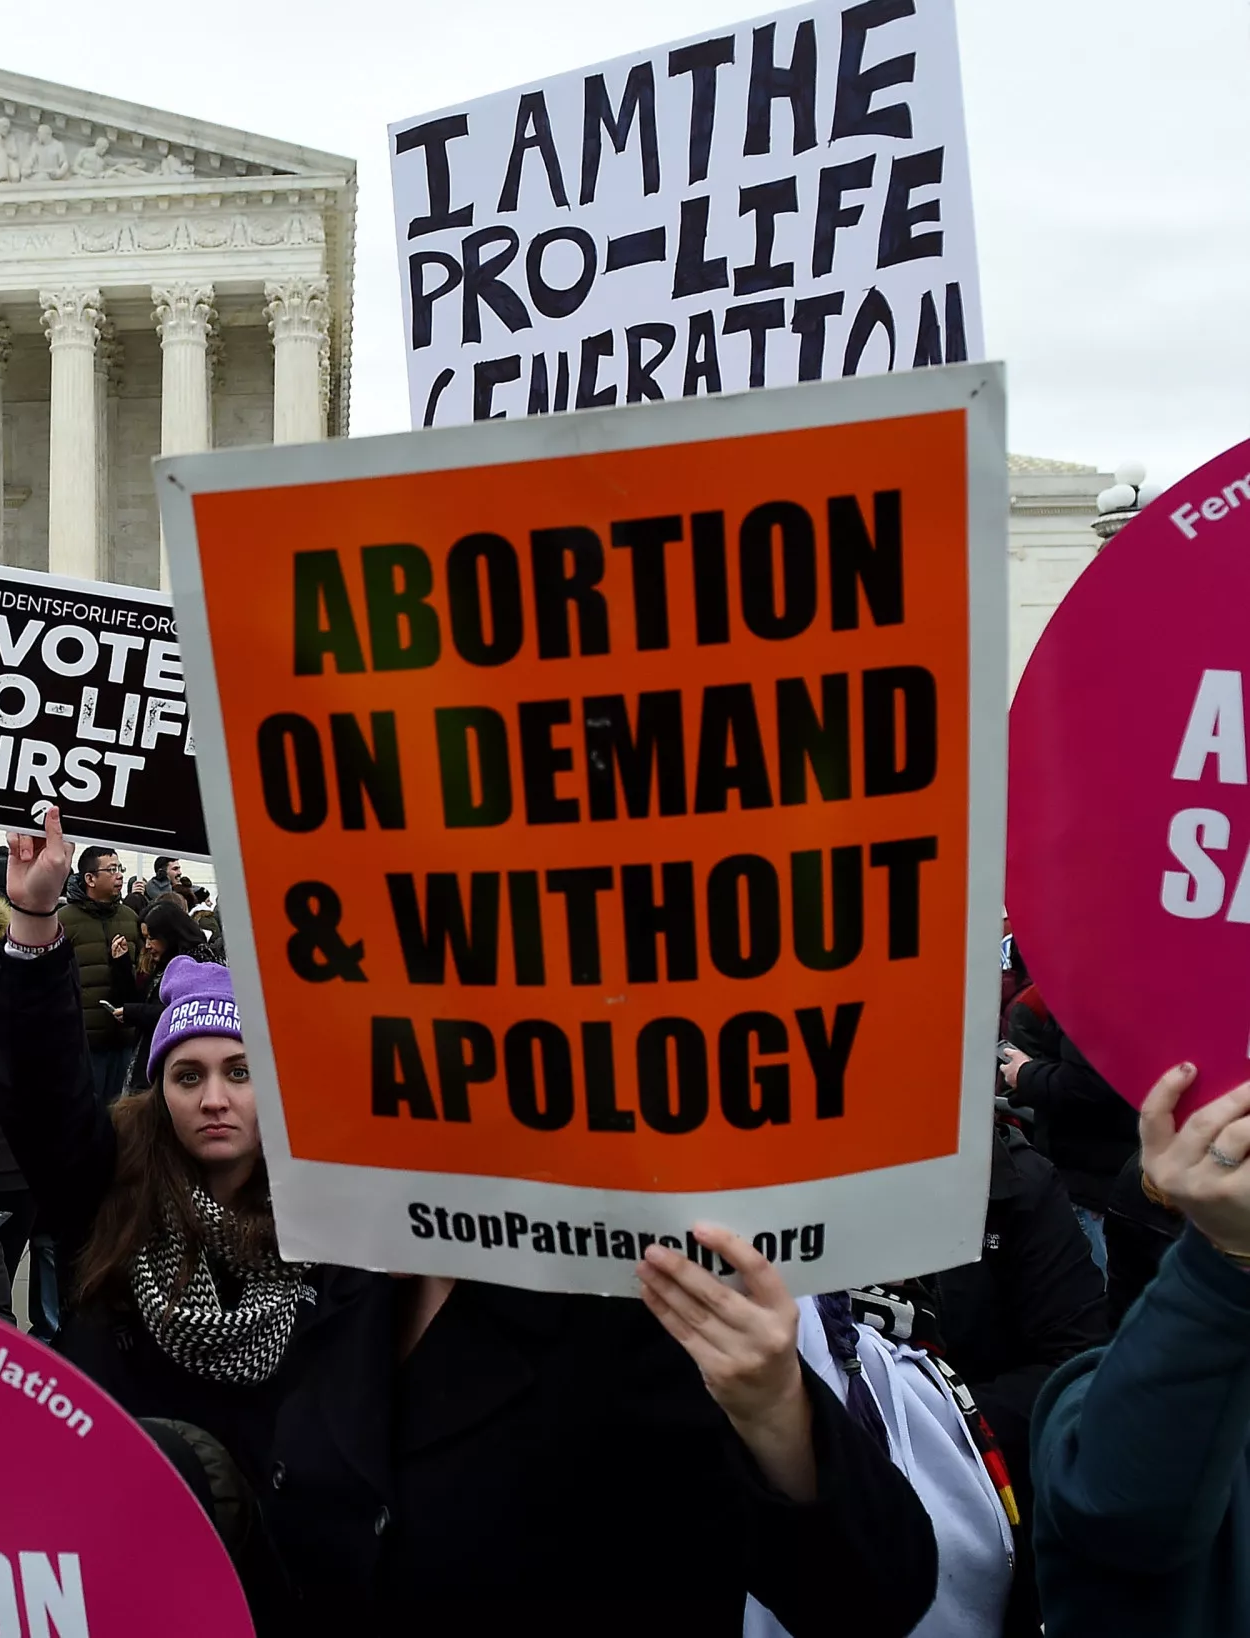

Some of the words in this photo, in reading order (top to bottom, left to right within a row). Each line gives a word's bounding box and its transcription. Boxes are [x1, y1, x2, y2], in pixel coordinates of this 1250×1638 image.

[12, 232, 56, 250] LAW
[395, 113, 475, 240] I
[409, 146, 944, 350] PRO-LIFE
[293, 490, 904, 676] ABORTION
[257, 711, 406, 833] ON
[435, 665, 938, 830] DEMAND
[284, 881, 368, 983] &
[386, 836, 938, 987] WITHOUT
[371, 1002, 864, 1135] APOLOGY
